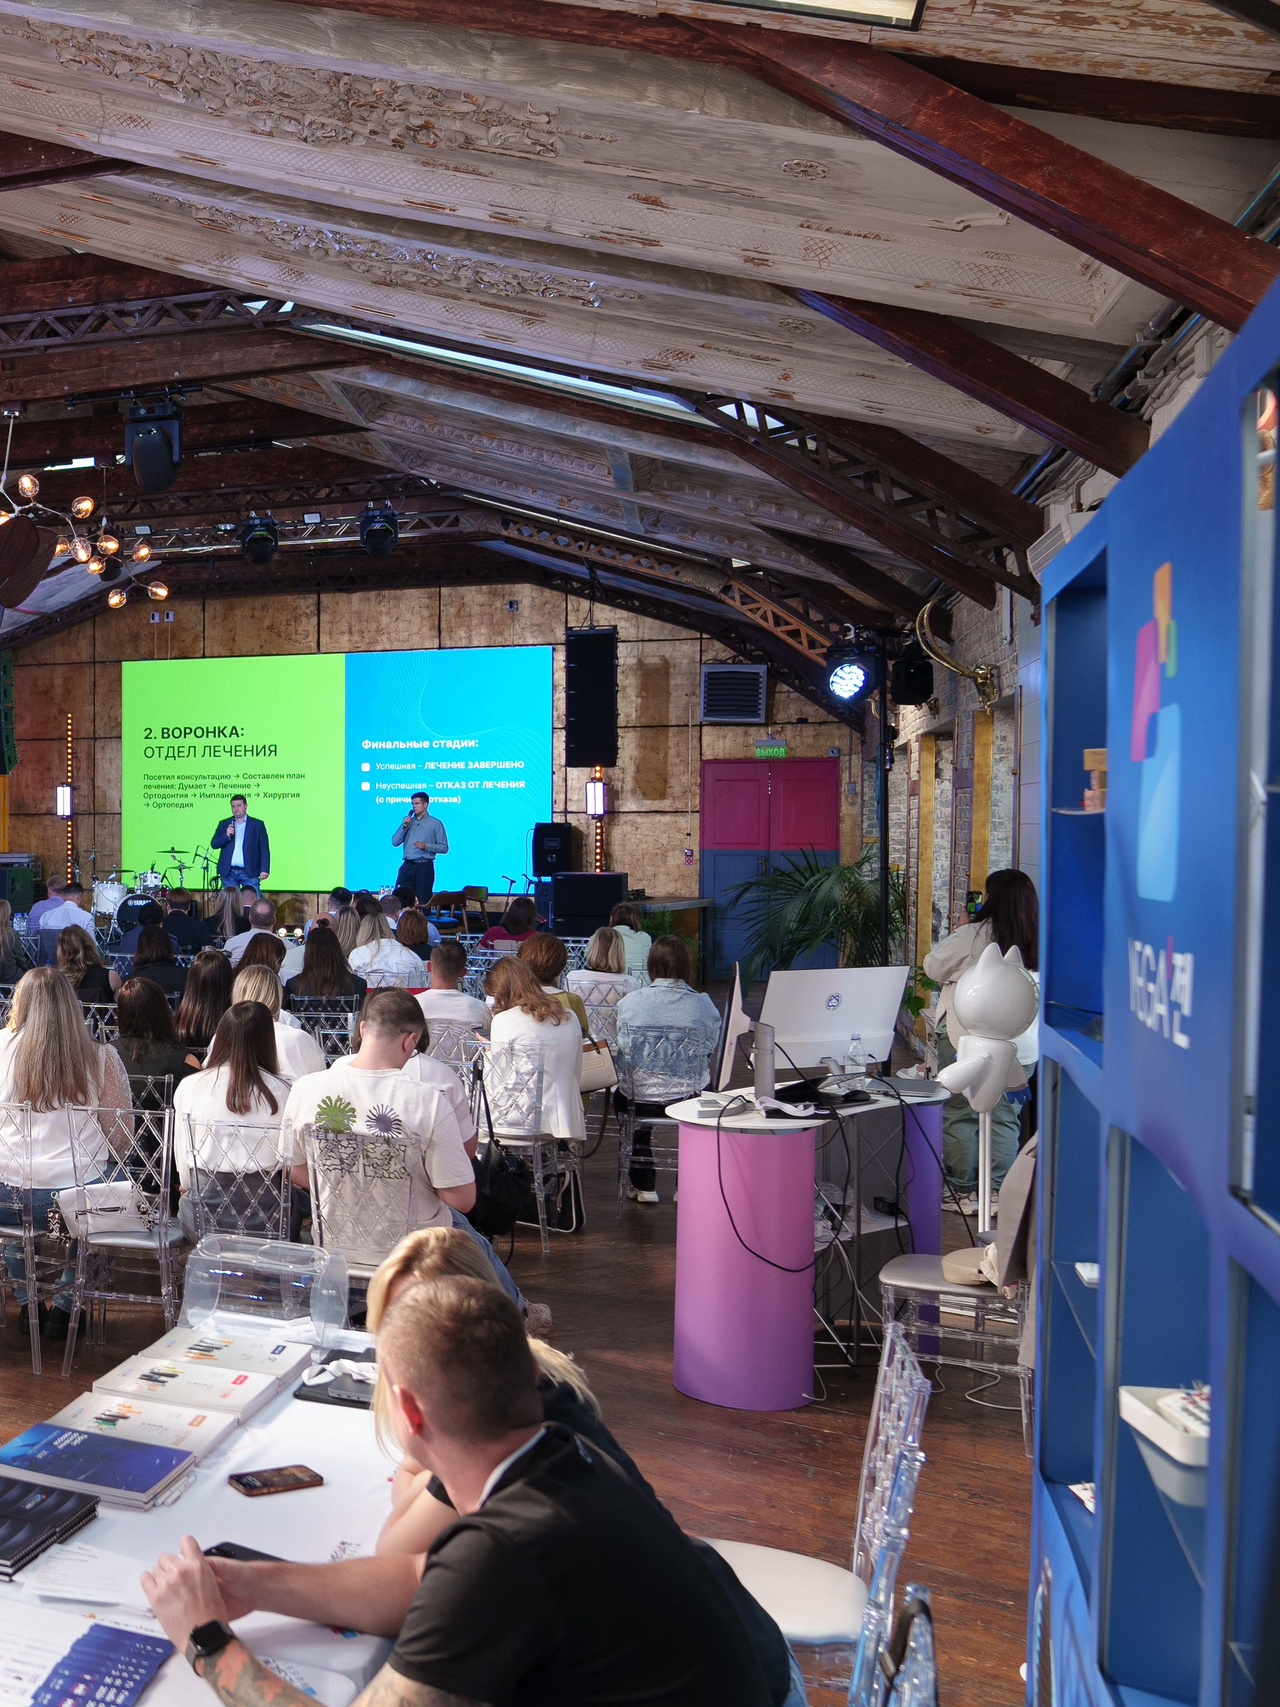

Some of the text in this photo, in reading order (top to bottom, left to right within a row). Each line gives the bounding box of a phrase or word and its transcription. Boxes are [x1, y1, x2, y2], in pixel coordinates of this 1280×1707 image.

[143, 725, 245, 740] 2. ВОРОНКА:
[361, 738, 479, 750] Финальные стадии:
[143, 744, 278, 761] ОТДЕЛ ЛЕЧЕНИЯ
[755, 747, 786, 758] ВЫХОД
[376, 762, 416, 771] Успешная
[424, 761, 466, 770] ЛЕЧЕНИЕ
[467, 760, 525, 769] ЗАВЕРШЕНО
[143, 772, 306, 782] Посетил консультацию Составлен план
[177, 782, 207, 791] Думает
[376, 781, 427, 791] Неуспешная
[435, 781, 466, 789] ОТКАЗ
[467, 780, 481, 789] ОТ
[482, 780, 526, 789] ЛЕЧЕНИЯ
[143, 792, 189, 801] Ортодонтия
[262, 791, 301, 801] Хирургия
[376, 796, 385, 805] (с
[428, 795, 462, 804] отказа)
[152, 801, 194, 810] Ортопедия
